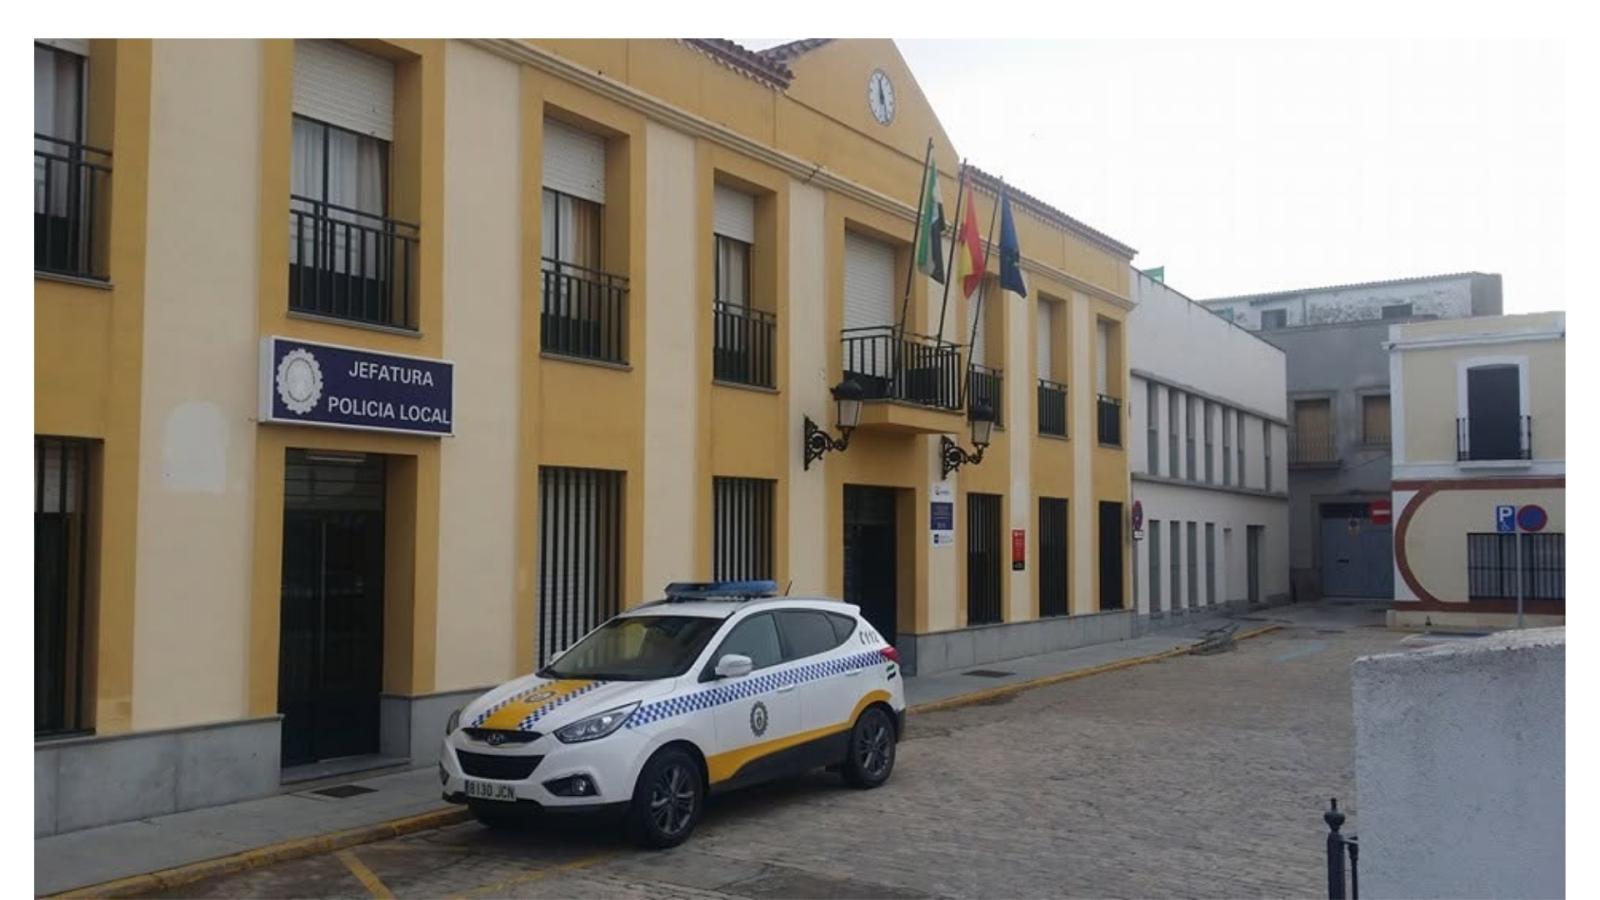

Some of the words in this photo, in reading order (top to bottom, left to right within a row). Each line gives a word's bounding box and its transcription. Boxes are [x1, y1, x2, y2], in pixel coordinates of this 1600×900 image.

[349, 361, 434, 387] JEFATURA
[328, 396, 395, 419] POLICIA
[400, 404, 450, 424] LOCAL
[1499, 507, 1513, 522] P
[495, 784, 515, 799] JCN
